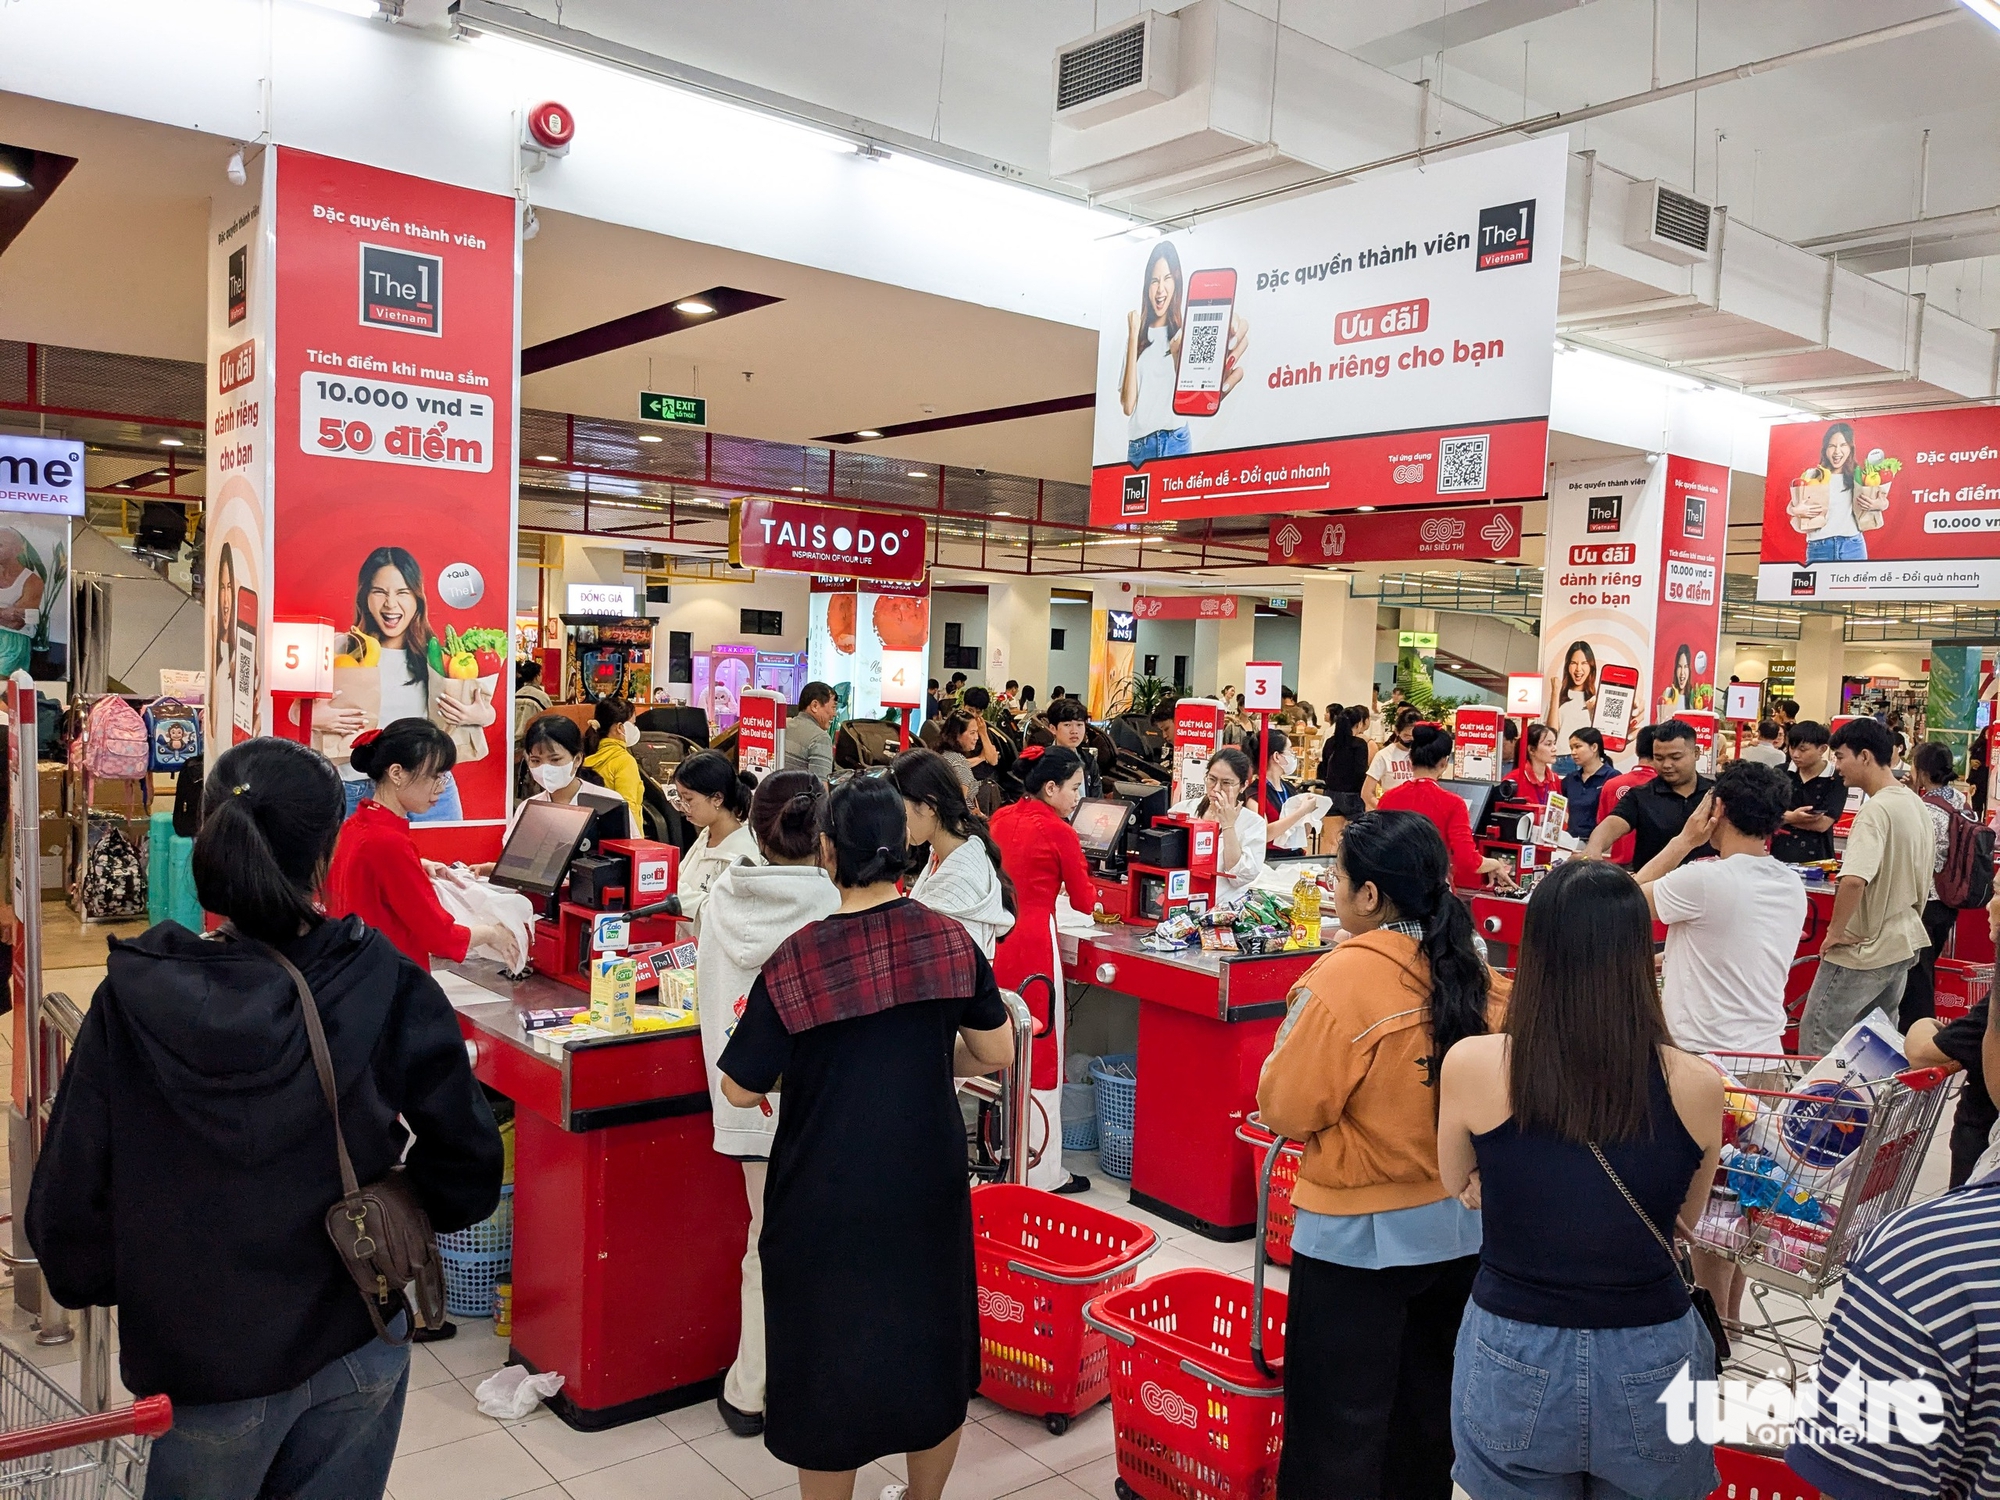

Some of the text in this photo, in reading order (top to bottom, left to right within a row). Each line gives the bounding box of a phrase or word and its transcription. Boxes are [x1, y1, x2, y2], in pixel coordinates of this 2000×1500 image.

[313, 204, 487, 251] Đặc quyền thành viên
[1256, 232, 1471, 292] Đặc quyền thành viên
[1484, 250, 1526, 266] Vietnam
[375, 306, 428, 326] Vietnam
[1340, 303, 1419, 341] Ưu đãi
[221, 347, 252, 389] Ưu đãi
[306, 349, 489, 387] Tích điểm khi mua sắm
[1267, 337, 1505, 390] dành riêng cho bạn
[317, 380, 484, 417] 10.000 vnd =
[676, 400, 696, 412] EXIT
[215, 399, 259, 437] dành riêng
[317, 417, 483, 464] 50 điểm
[220, 442, 253, 473] cho bạn
[1414, 453, 1432, 462] dụng
[1916, 445, 1998, 466] Đặc quyền
[1162, 462, 1331, 491] Tích điểm dễ Đổi quà nhanh
[1569, 478, 1646, 491] Đặc quyền thành viên
[1911, 487, 1951, 504] Tích
[1591, 523, 1616, 531] Vietnam
[1932, 517, 1981, 530] 10.000
[1434, 542, 1450, 551] SIÊU
[1452, 543, 1465, 551] THỊ
[1573, 546, 1629, 563] Ưu đãi
[791, 550, 872, 565] INSPIRATION OF YOUR LIFE
[446, 568, 470, 579] +Quà
[1559, 571, 1642, 587] dành riêng
[1670, 564, 1707, 578] 10.000 vnd
[1830, 570, 1980, 584] Tích điểm dễ Đổi quà nhanh
[1669, 580, 1711, 602] 50 điểm
[1569, 592, 1630, 608] cho bạn
[285, 645, 300, 670] 5
[324, 646, 330, 672] 5
[892, 668, 905, 687] 4
[1255, 679, 1267, 695] 3
[1518, 689, 1528, 702] 2
[1738, 696, 1745, 709] 1
[743, 716, 773, 728] QUÉT MÃ QR
[1179, 719, 1194, 728] QUÉT
[1195, 721, 1204, 729] MÃ
[1460, 723, 1474, 731] QUÉT
[750, 728, 760, 738] Deal
[1187, 729, 1199, 737] Deal
[1468, 731, 1481, 739] Deal
[606, 923, 621, 931] Zalo
[606, 931, 619, 939] Pay
